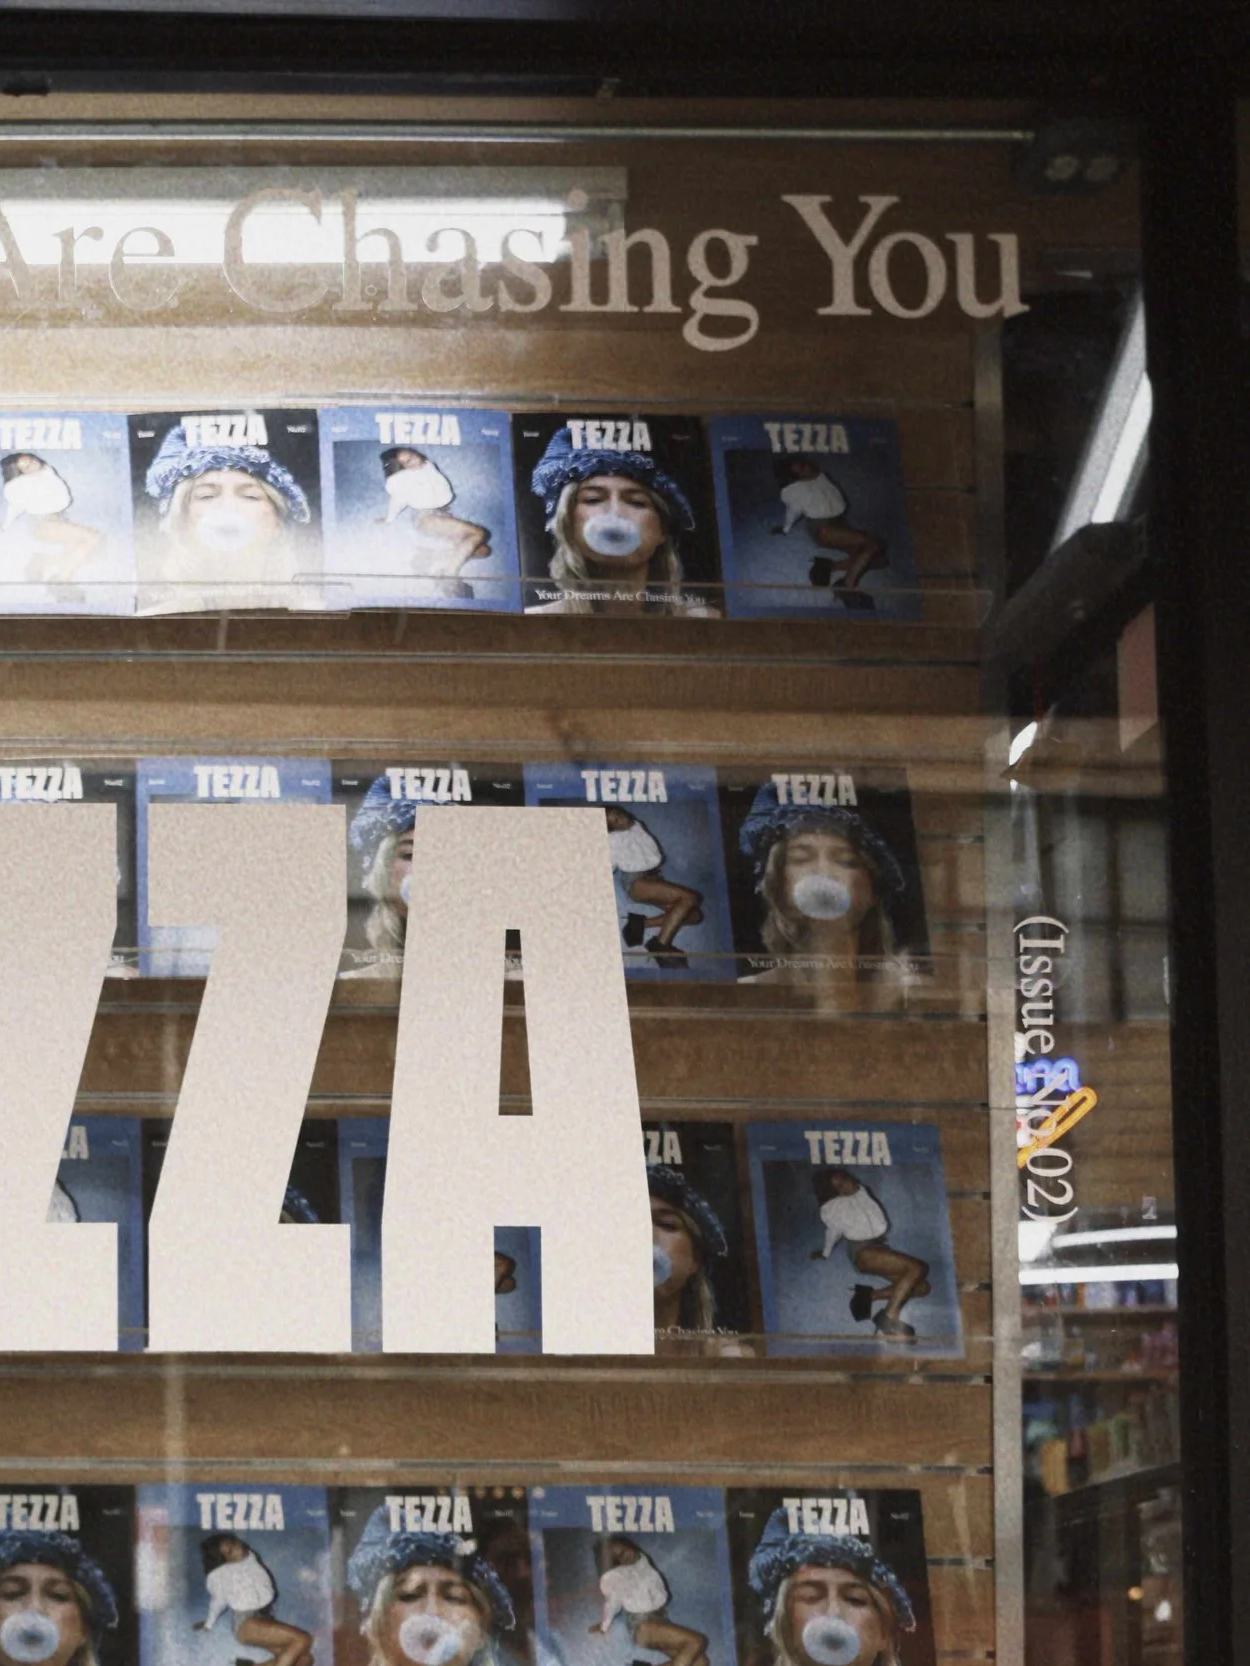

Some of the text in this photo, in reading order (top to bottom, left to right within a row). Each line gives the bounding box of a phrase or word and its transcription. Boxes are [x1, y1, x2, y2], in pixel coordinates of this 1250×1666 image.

[223, 187, 759, 351] Chasing
[781, 194, 1030, 319] You
[180, 414, 268, 446] TEZZA
[375, 412, 461, 446] TEZZA
[566, 419, 651, 451] TEZZA
[763, 421, 849, 453] TEZZA
[535, 590, 562, 601] Your
[564, 590, 611, 601] Dreams
[613, 591, 635, 602] Are
[194, 765, 281, 798] TEZZA
[385, 768, 472, 803] TEZZA
[581, 769, 668, 803] TEZZA
[770, 774, 858, 807] TEZZA
[1013, 915, 1070, 1056] (Issue
[804, 1130, 892, 1166] TEZZA
[196, 1493, 284, 1531] TEZZA
[385, 1495, 473, 1533] TEZZA
[586, 1495, 675, 1534] TEZZA
[782, 1497, 870, 1536] TEZZA
